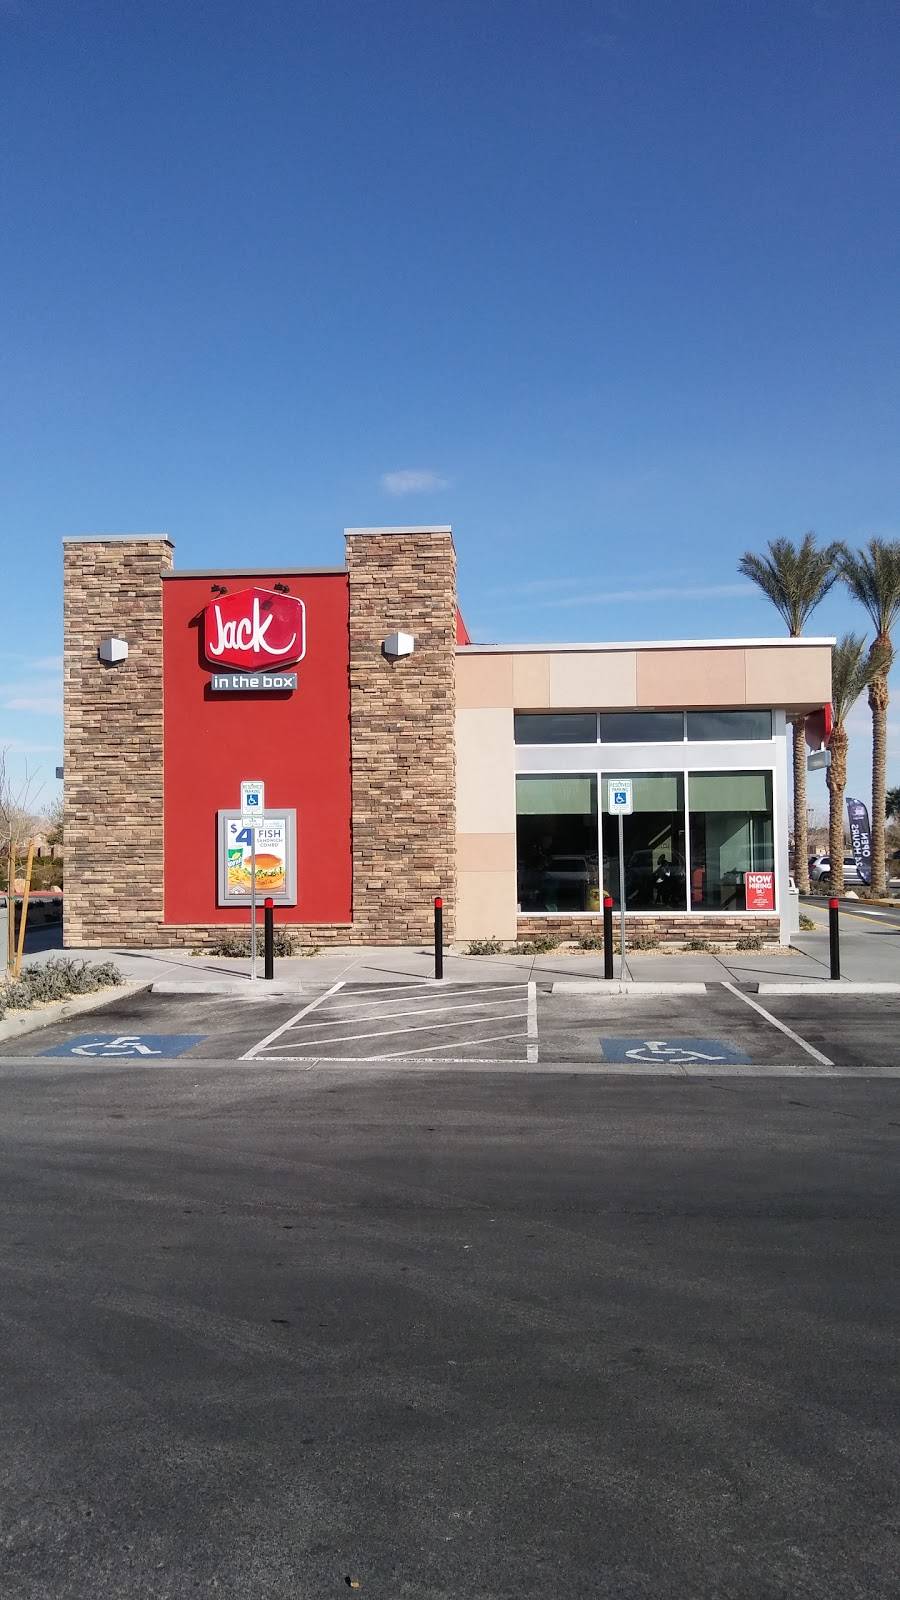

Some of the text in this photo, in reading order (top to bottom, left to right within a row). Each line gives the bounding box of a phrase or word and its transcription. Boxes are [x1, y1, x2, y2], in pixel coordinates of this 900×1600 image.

[209, 597, 297, 656] Jack
[214, 675, 293, 688] in the box
[258, 829, 281, 838] FISH
[748, 875, 772, 883] NOW
